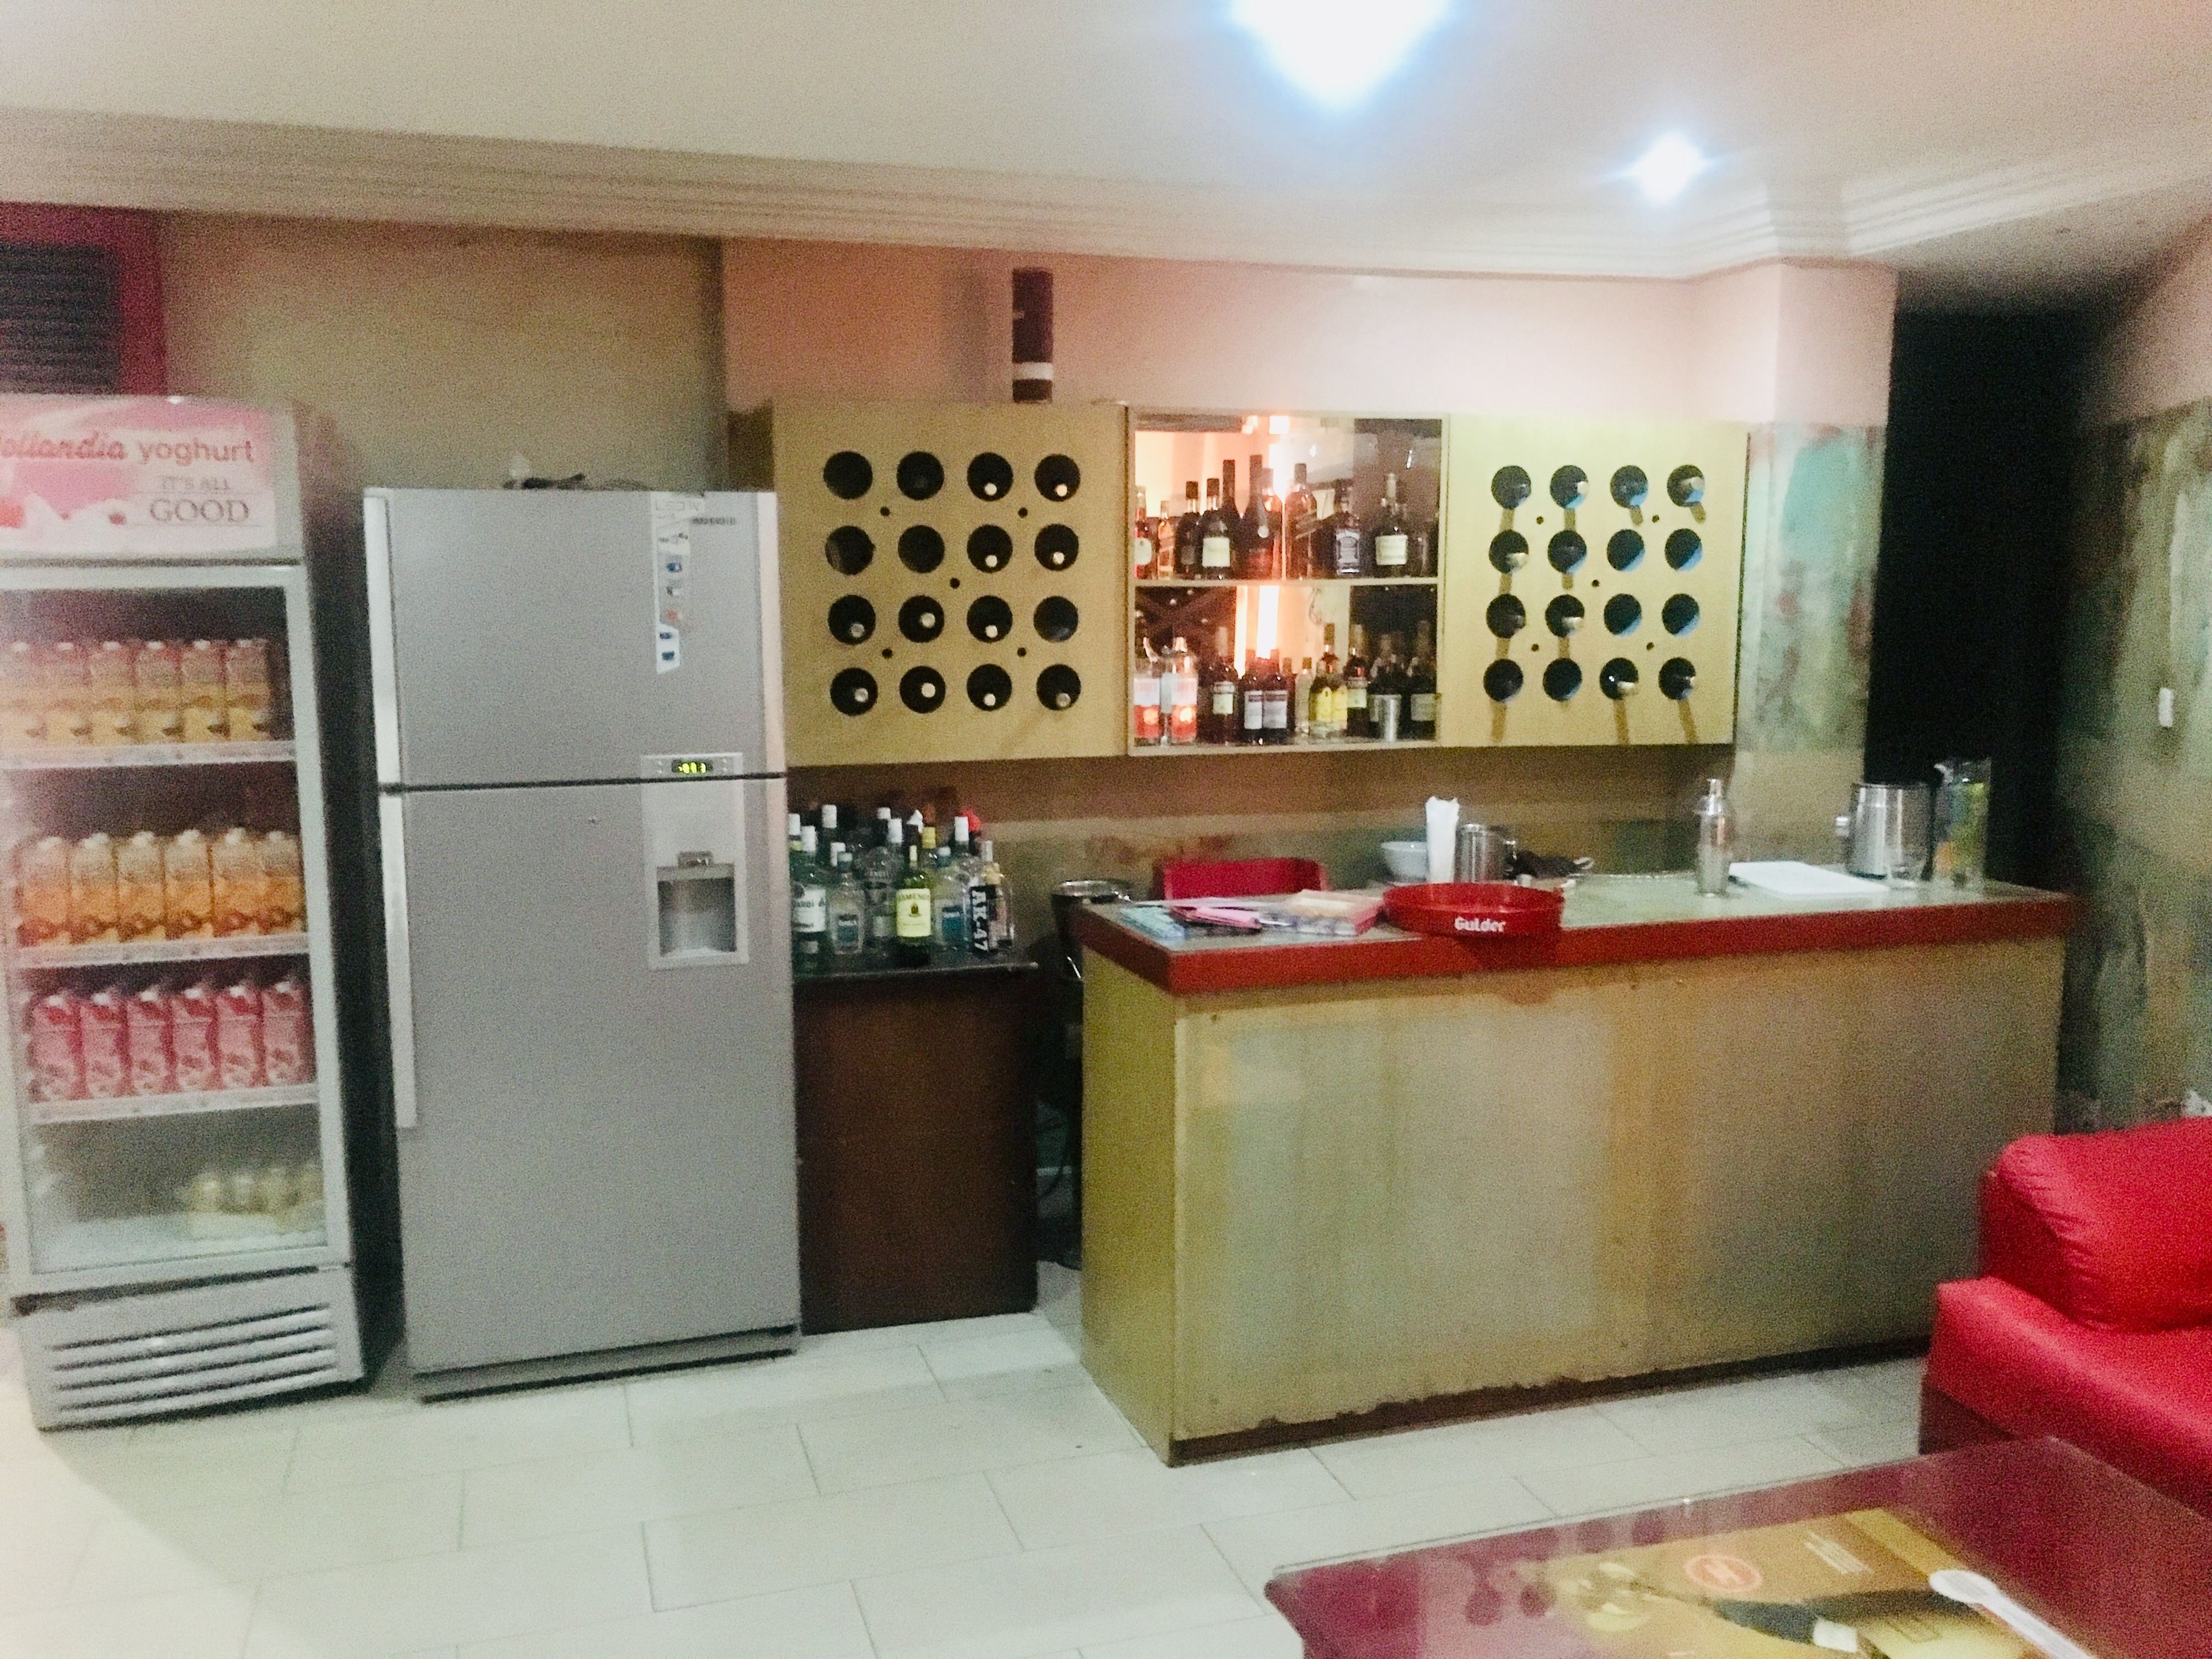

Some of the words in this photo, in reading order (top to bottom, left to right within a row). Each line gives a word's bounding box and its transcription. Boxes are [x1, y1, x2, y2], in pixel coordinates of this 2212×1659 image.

[0, 430, 127, 459] ollandia
[138, 437, 255, 466] yoghurt
[200, 475, 230, 490] ALL
[149, 498, 249, 522] GOOD
[1454, 915, 1506, 933] Gulder
